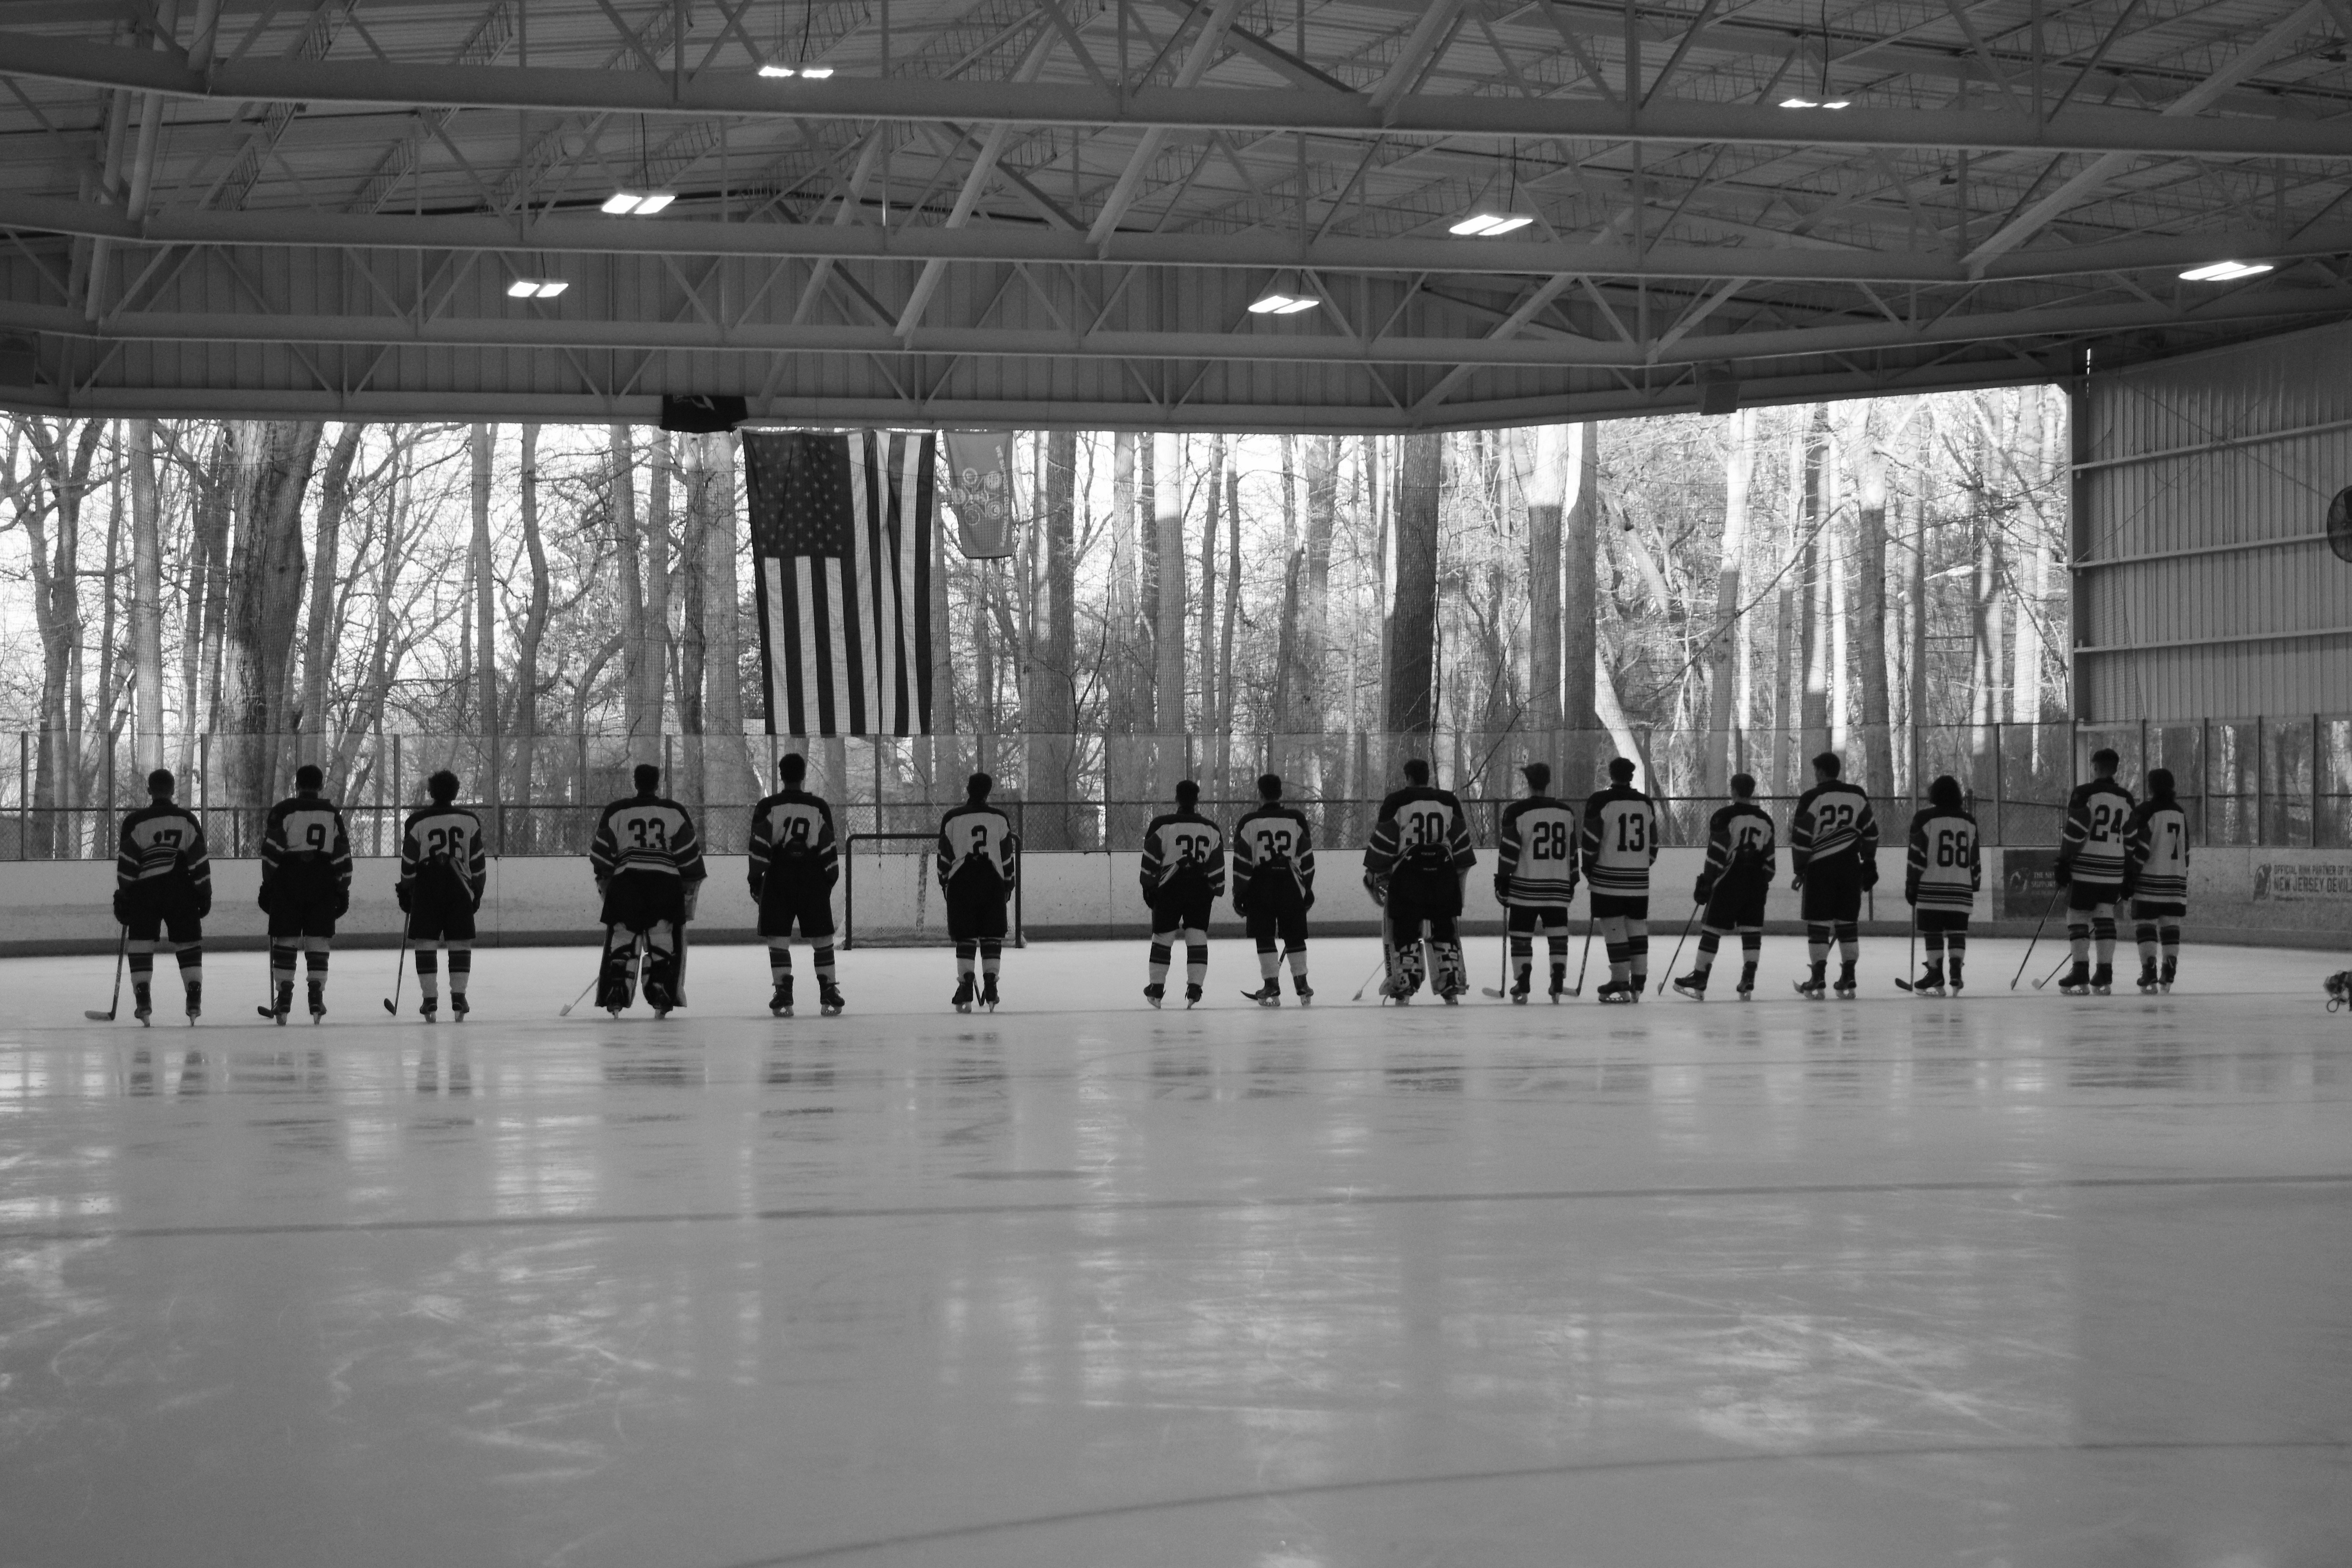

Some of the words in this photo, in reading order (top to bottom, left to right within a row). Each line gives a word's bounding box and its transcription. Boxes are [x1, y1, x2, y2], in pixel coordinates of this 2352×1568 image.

[628, 817, 666, 848] 33
[1406, 812, 1444, 845] 30
[1617, 813, 1645, 851] 13
[1820, 804, 1854, 831] 22
[2089, 804, 2123, 843] 24
[428, 826, 464, 858] 26
[971, 825, 988, 856] 2
[1176, 835, 1210, 862] 36
[1258, 830, 1291, 863] 32
[1533, 821, 1566, 860] 28
[1937, 829, 1969, 868] 68
[2167, 823, 2180, 859] 7
[2274, 877, 2290, 891] NEW
[2293, 877, 2324, 892] JERSEY
[2327, 878, 2352, 893] DEVIL
